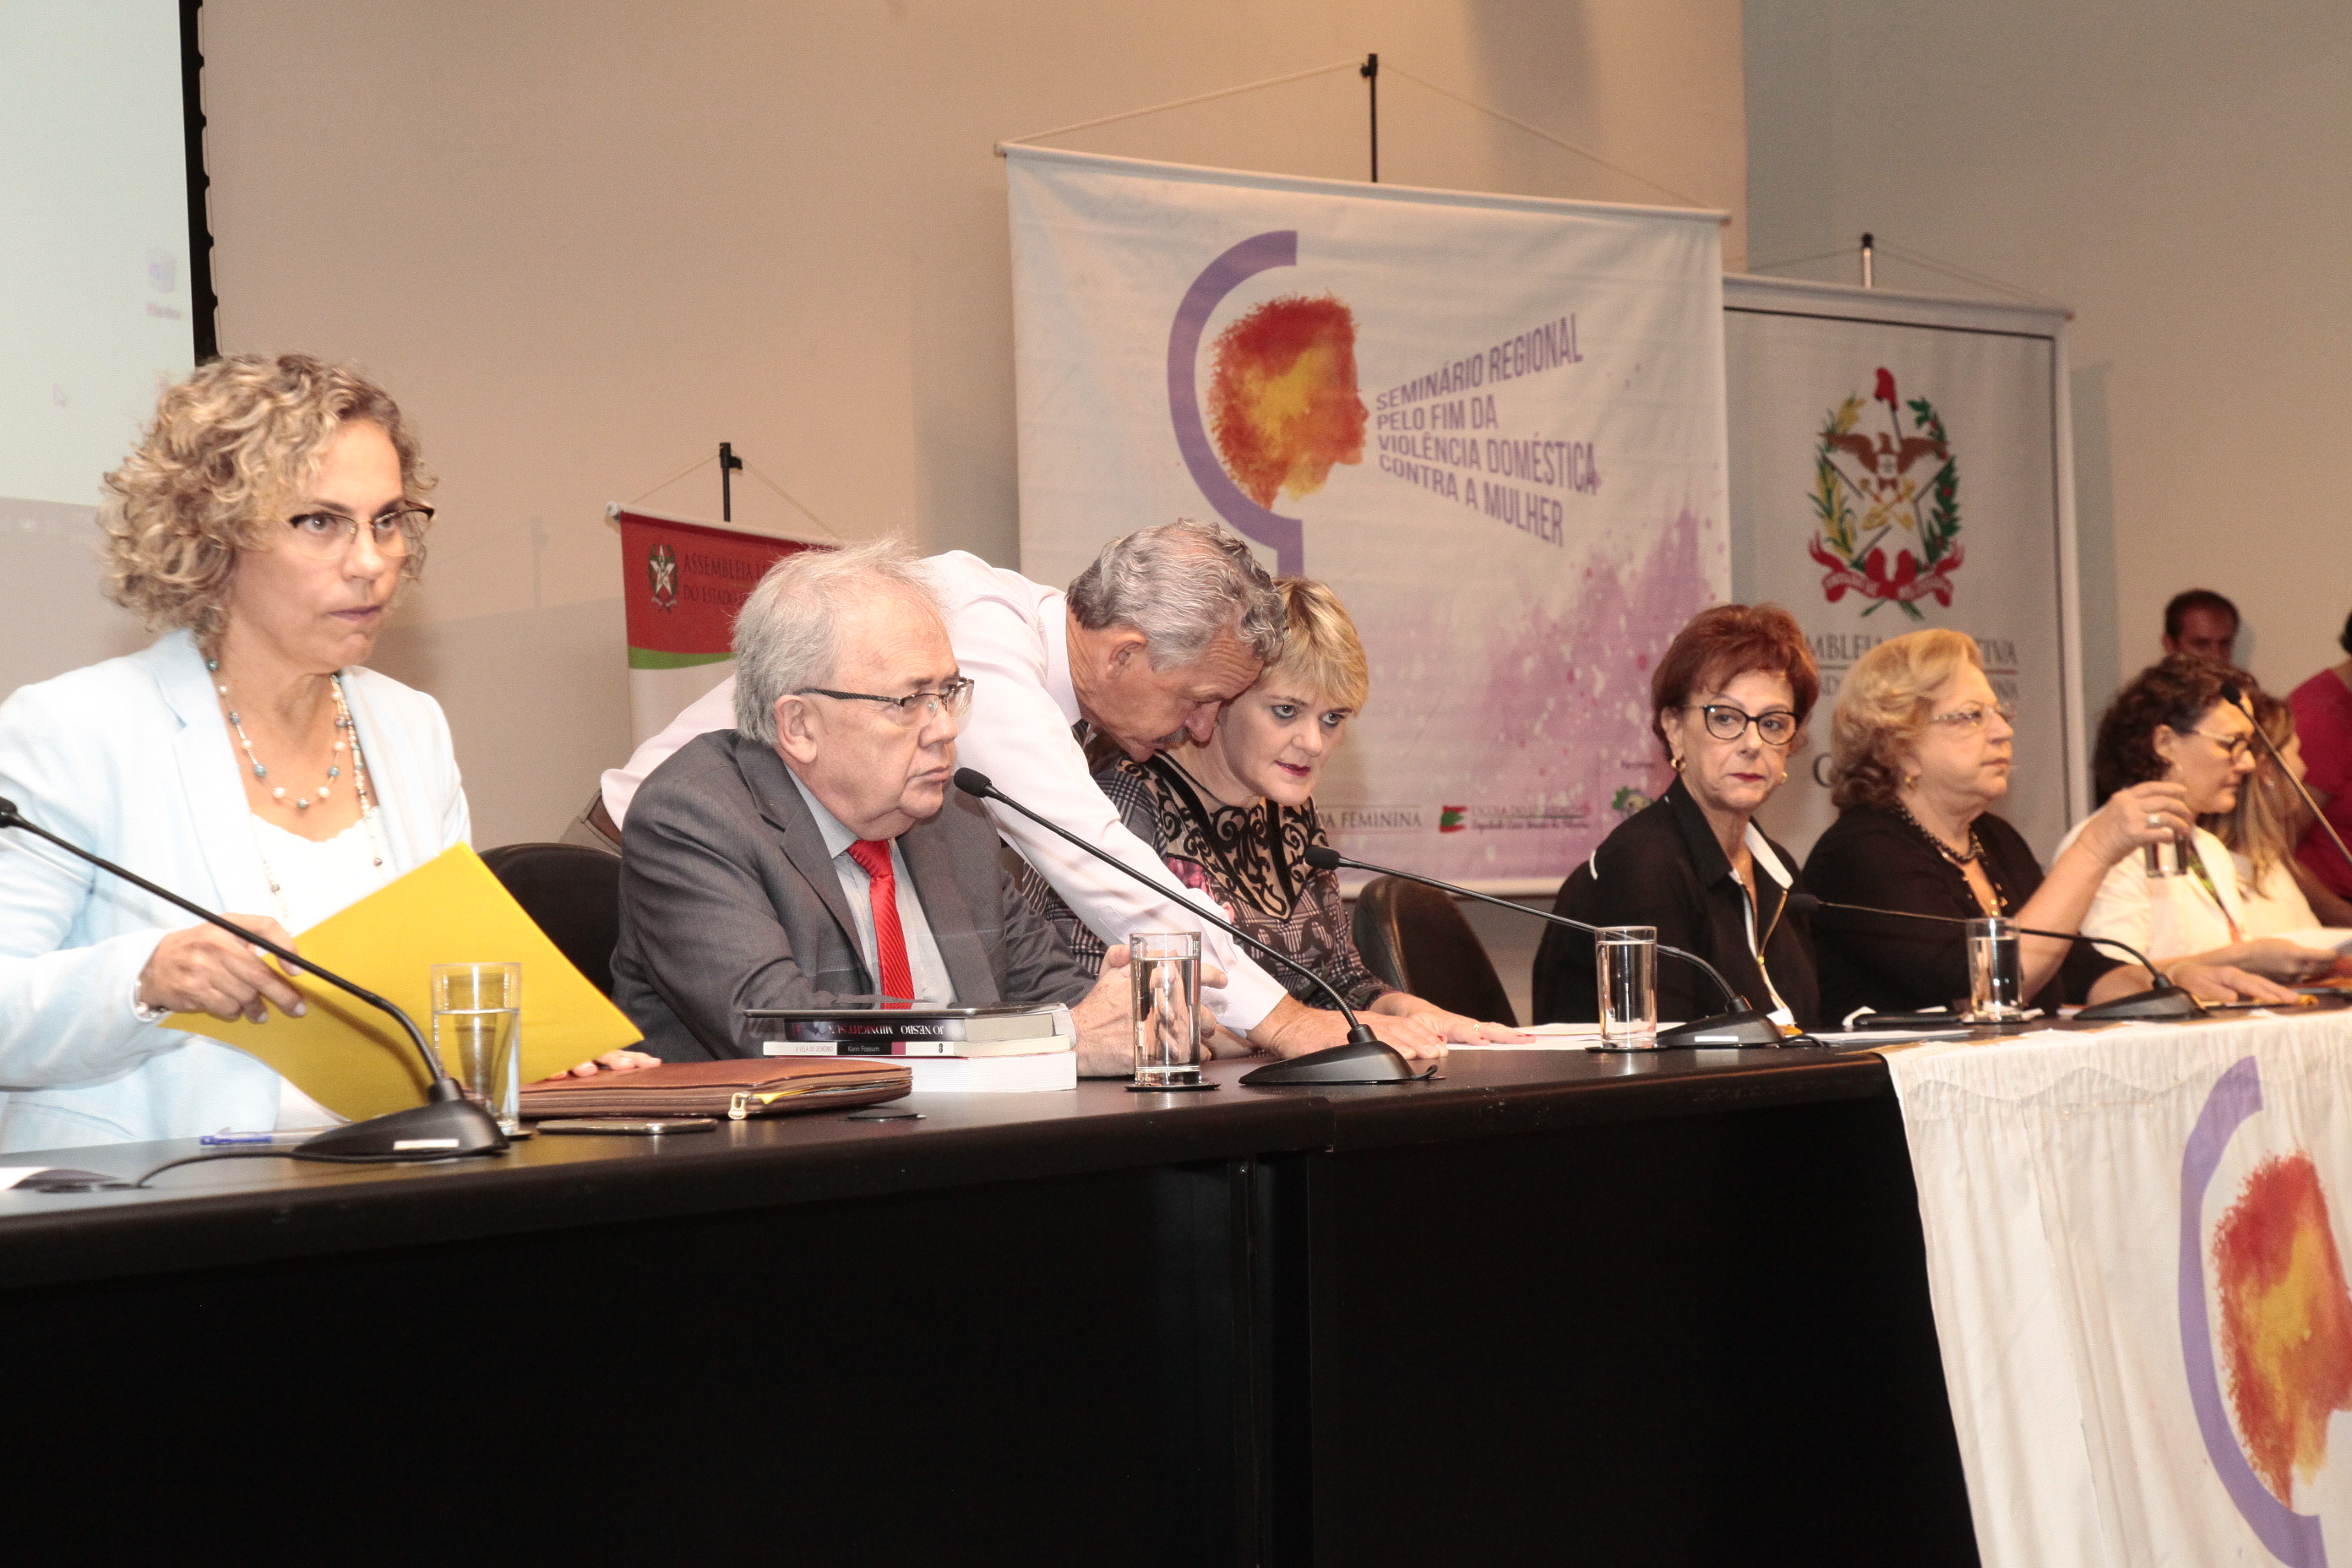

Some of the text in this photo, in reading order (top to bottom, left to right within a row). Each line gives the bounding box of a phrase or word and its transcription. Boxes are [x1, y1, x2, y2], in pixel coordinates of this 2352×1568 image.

[1376, 313, 1582, 411] SEMINÁRIO REGIONAL
[1377, 394, 1498, 430] PELO FIM DA
[1378, 431, 1598, 496] VIOLÊNCIA DOMÉSTICA
[1379, 454, 1563, 548] CONTRA A MULHER
[683, 553, 755, 583] ASSEMBLEIA
[1341, 812, 1423, 828] FEMININA
[847, 1025, 894, 1035] MIDNIGHT
[933, 1025, 944, 1035] JO
